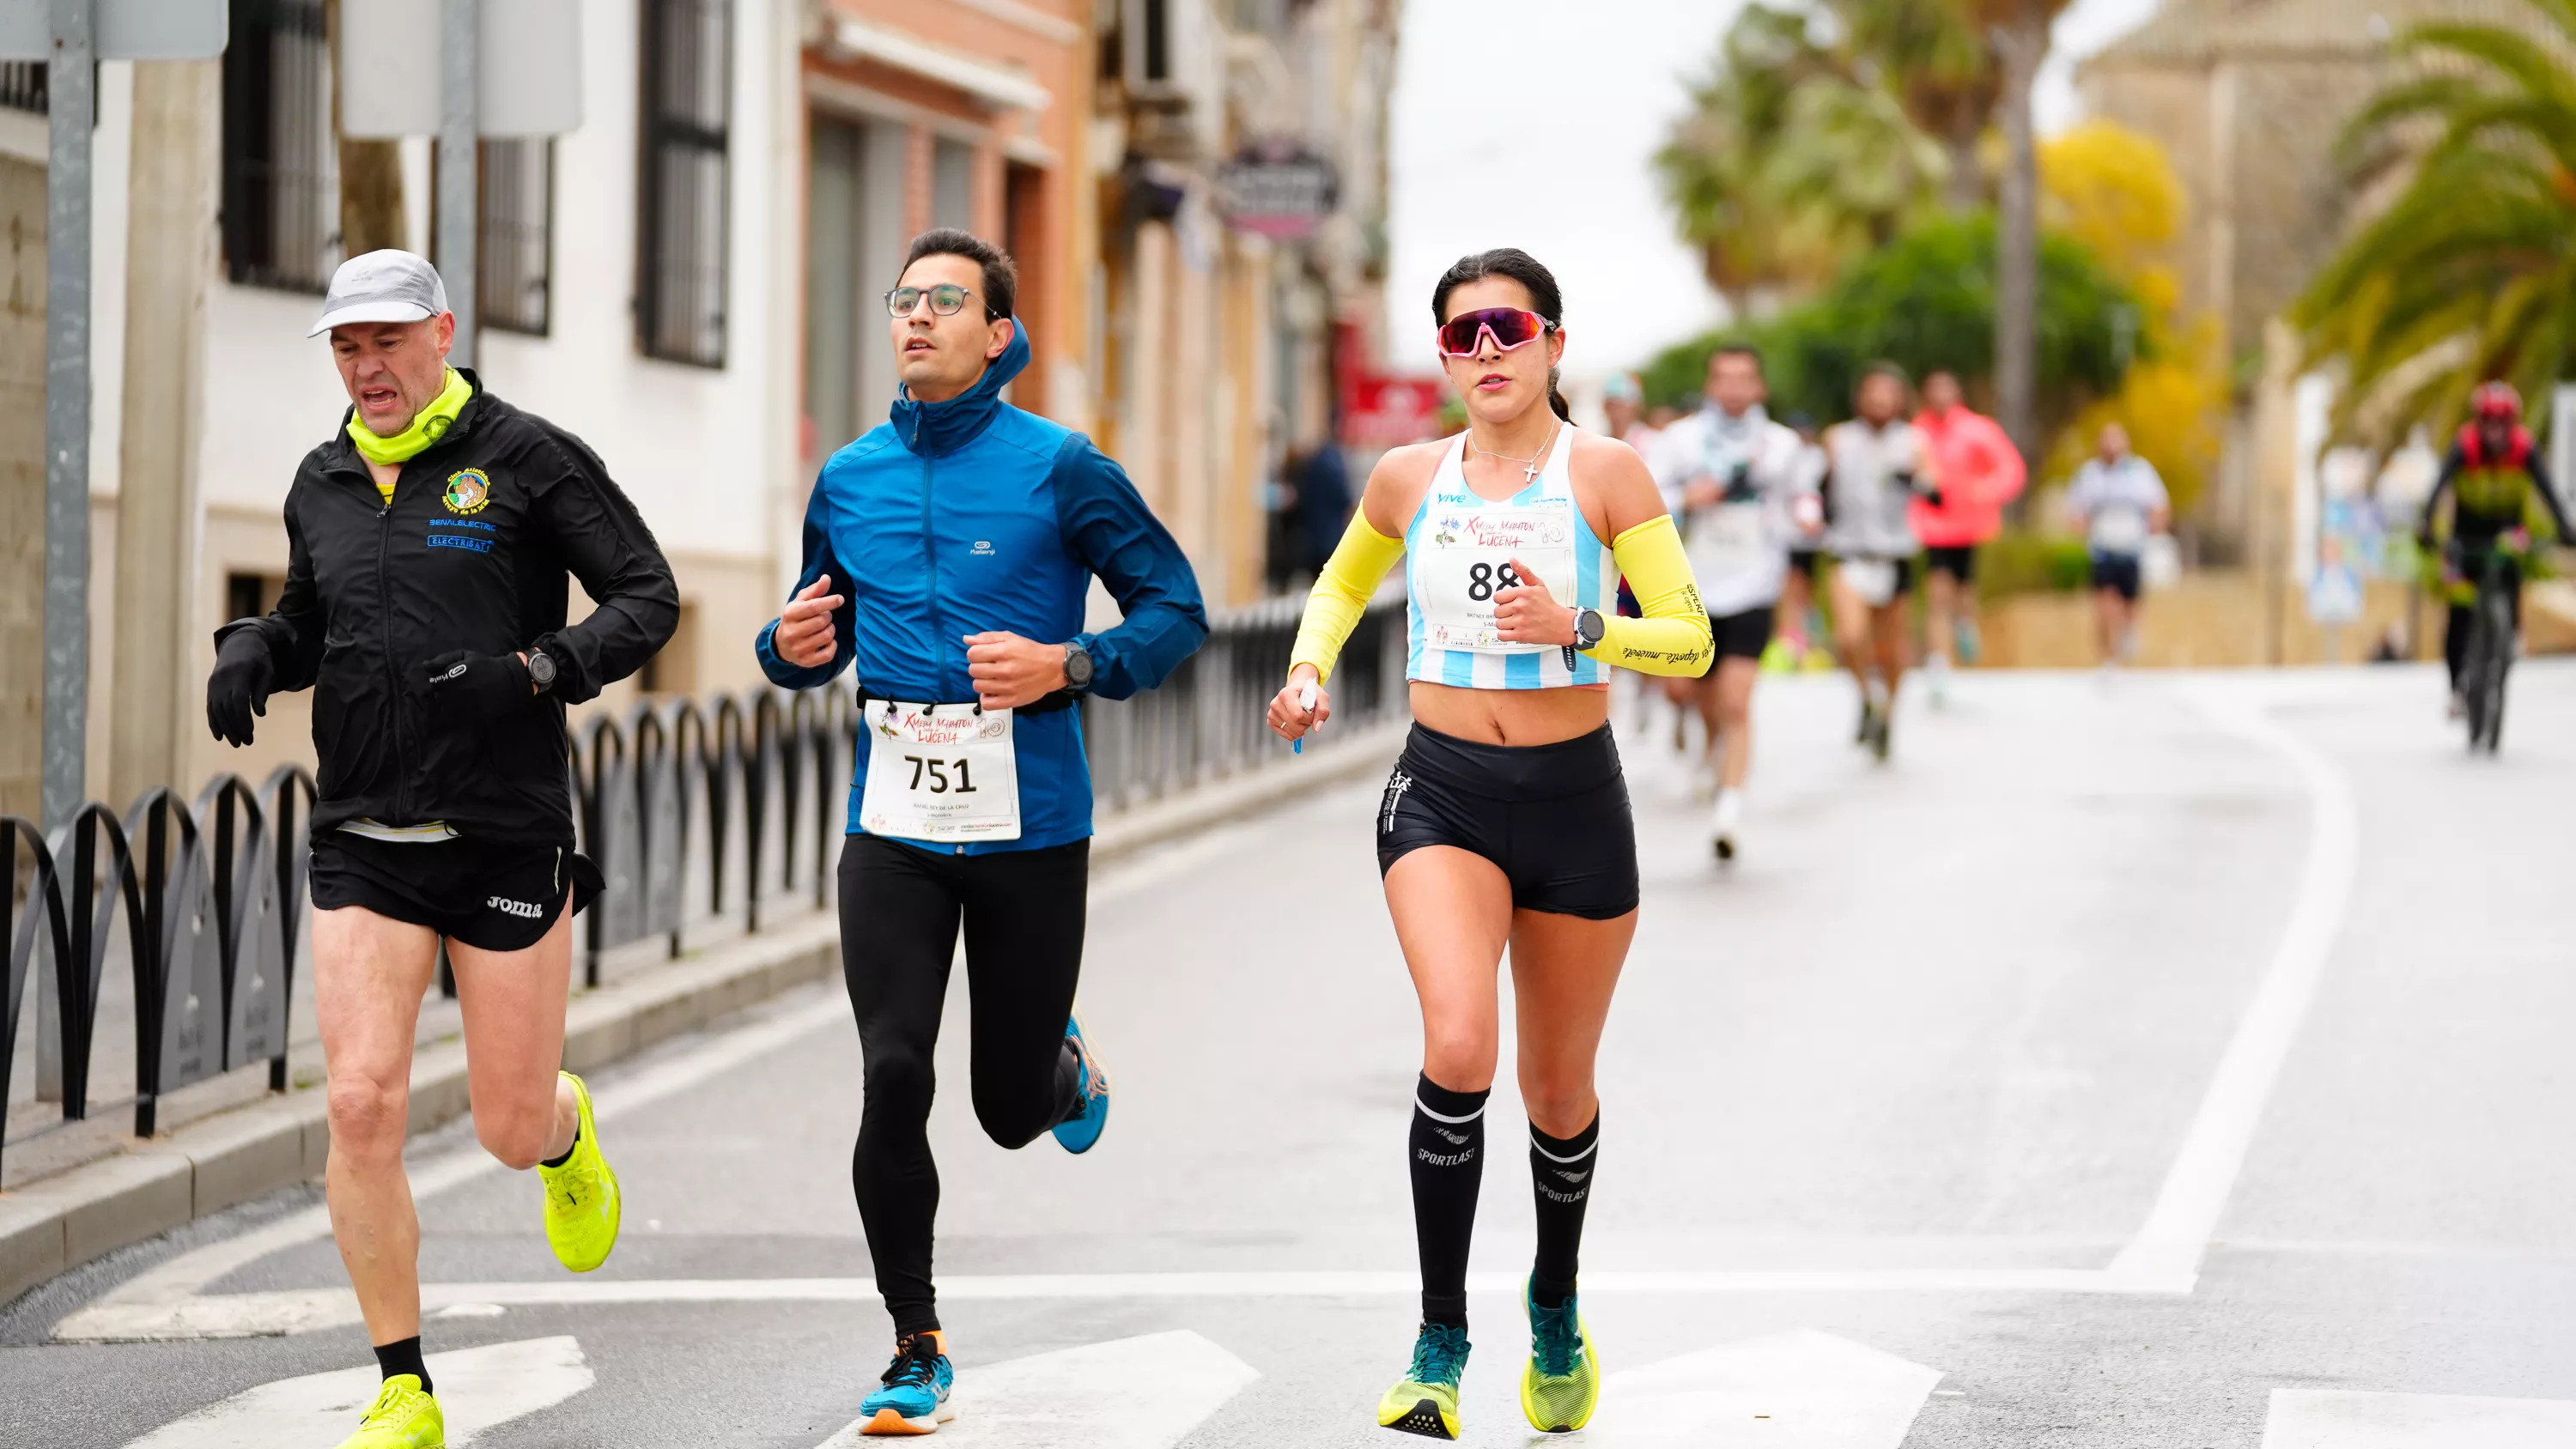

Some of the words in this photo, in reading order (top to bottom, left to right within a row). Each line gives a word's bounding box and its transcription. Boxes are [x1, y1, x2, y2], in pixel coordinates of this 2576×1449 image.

[918, 729, 963, 745] LUCENA
[904, 755, 977, 794] 751
[487, 896, 543, 918] Joma
